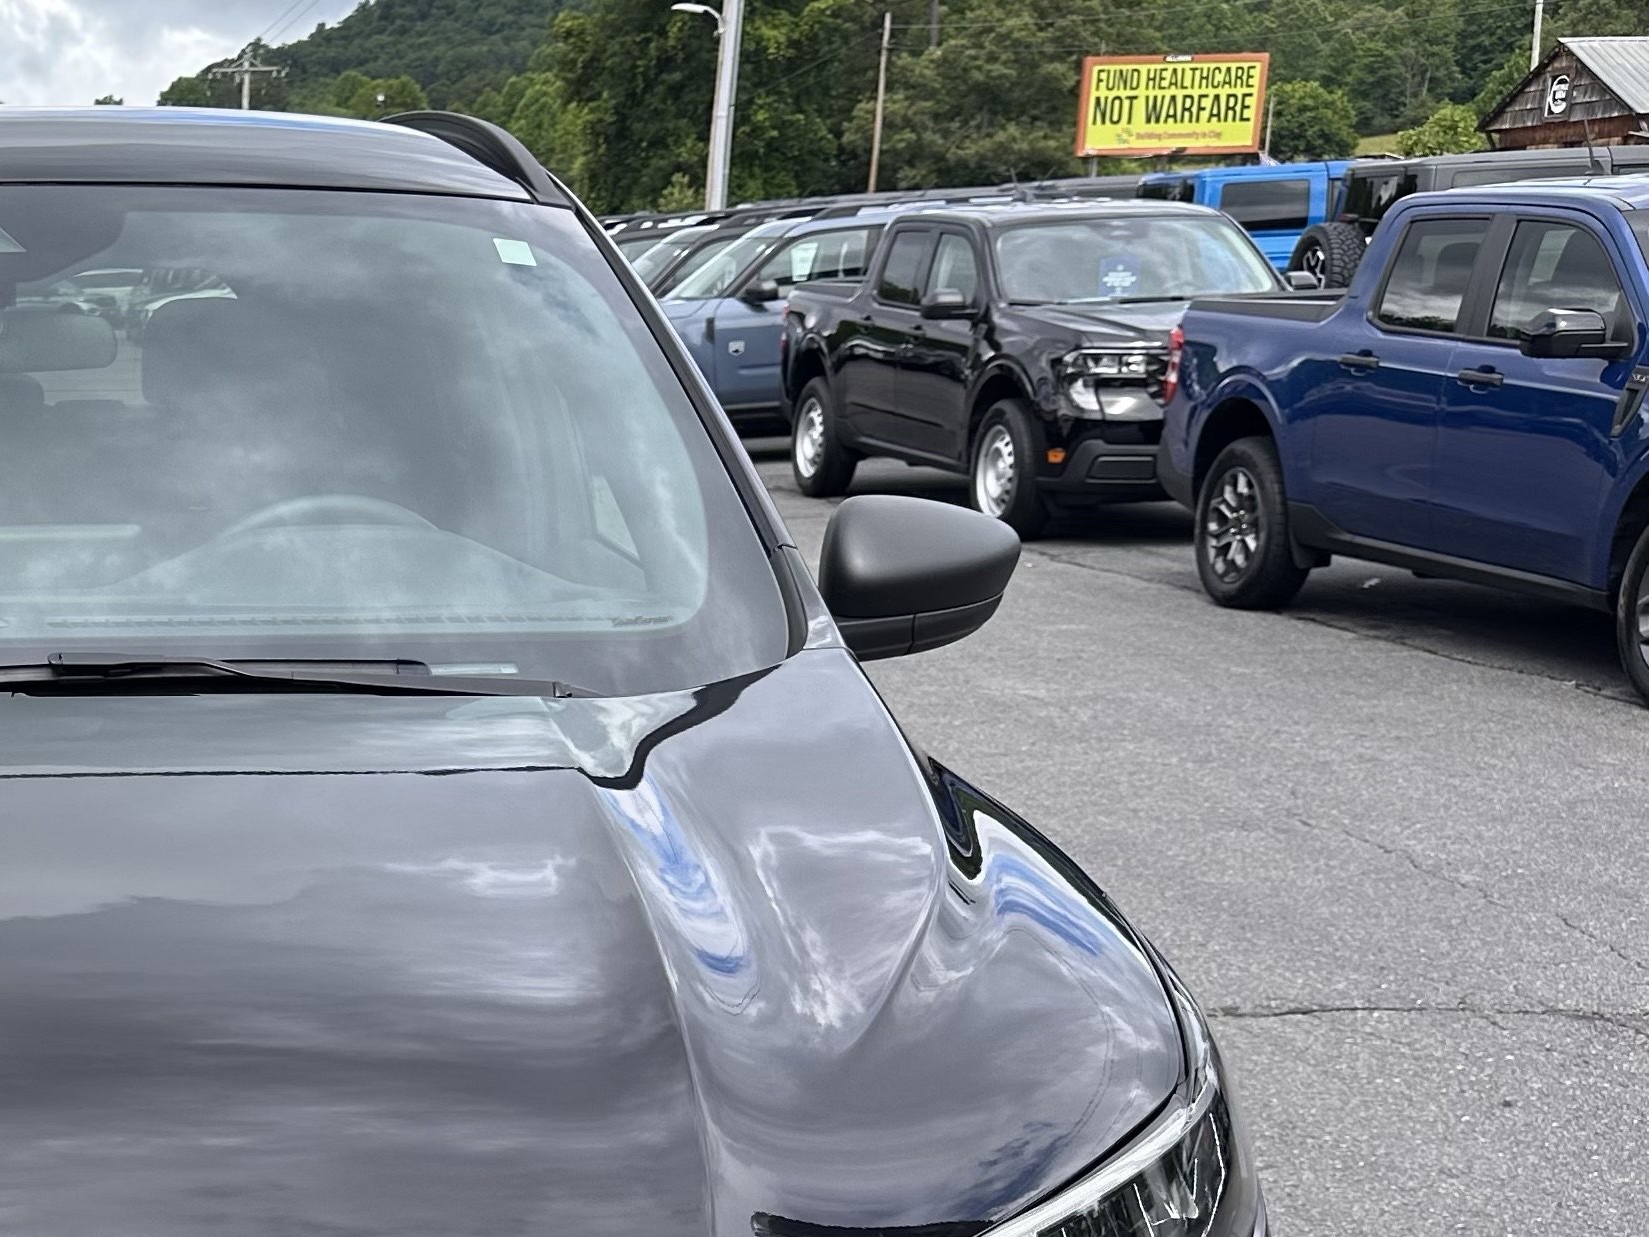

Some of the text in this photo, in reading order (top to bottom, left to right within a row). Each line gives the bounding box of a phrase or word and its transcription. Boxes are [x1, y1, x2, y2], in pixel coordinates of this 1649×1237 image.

[1095, 65, 1257, 92] FUND HEALTHCARE
[1092, 92, 1254, 126] NOT WARFARE
